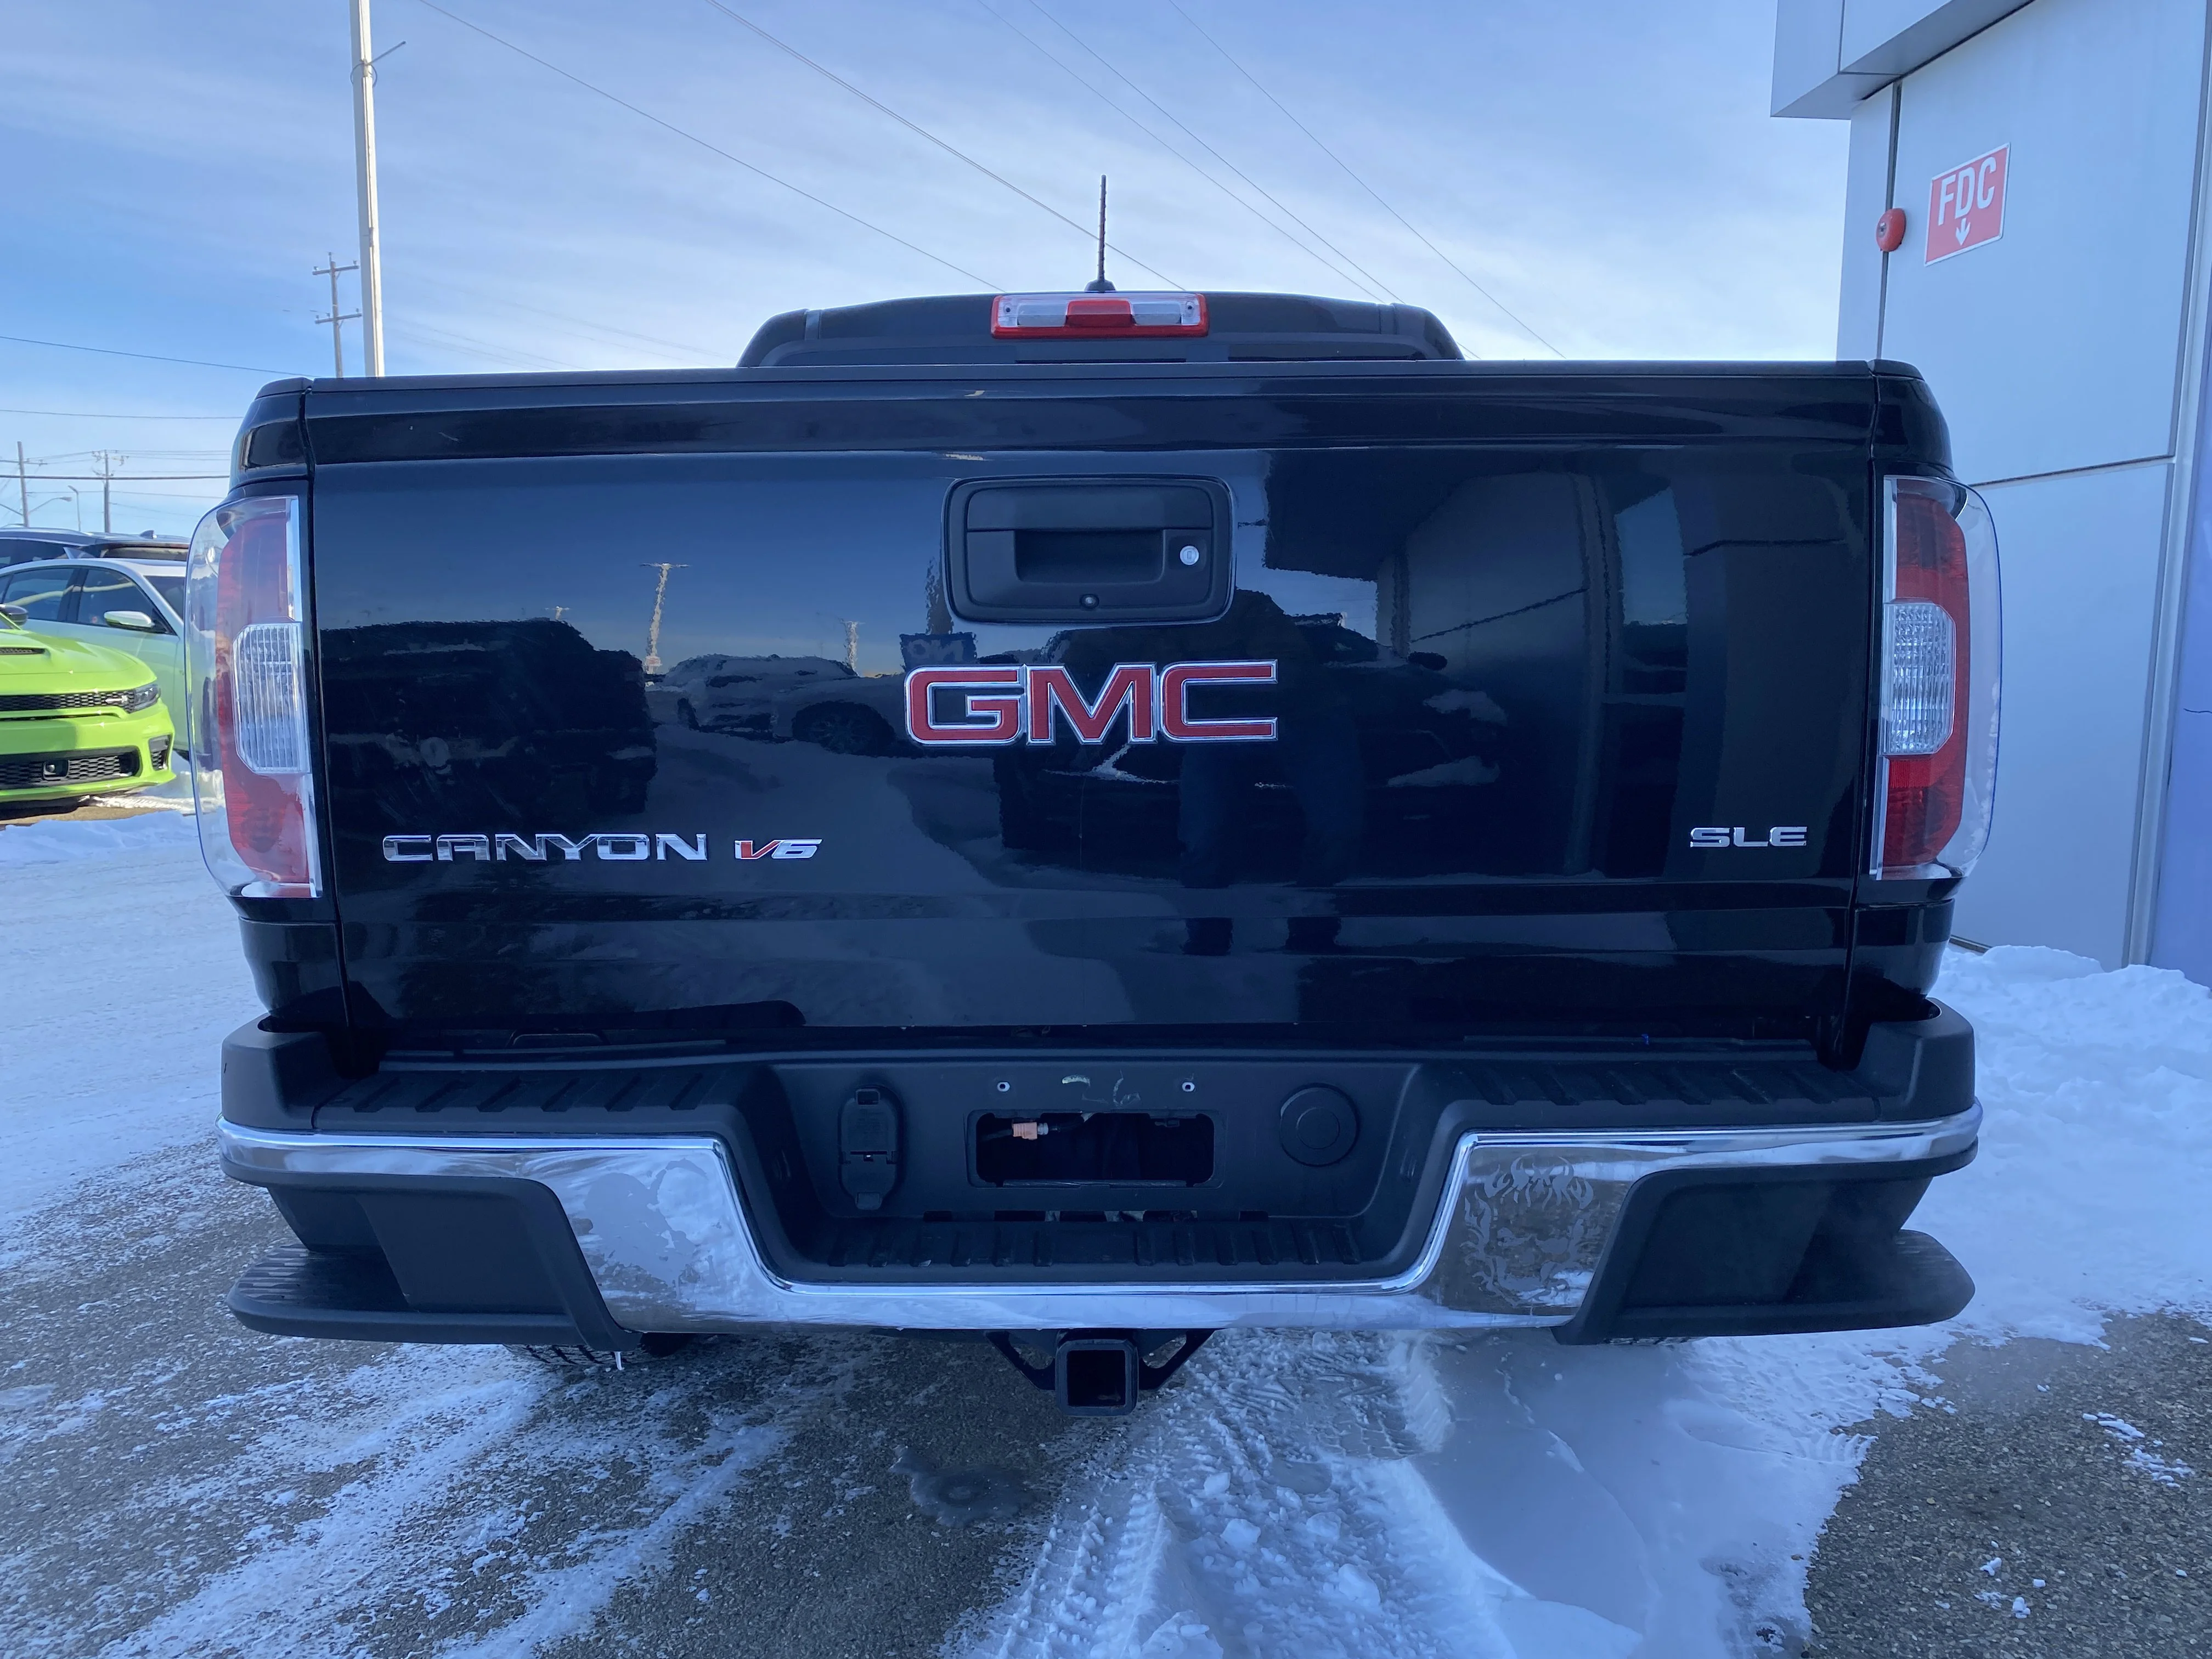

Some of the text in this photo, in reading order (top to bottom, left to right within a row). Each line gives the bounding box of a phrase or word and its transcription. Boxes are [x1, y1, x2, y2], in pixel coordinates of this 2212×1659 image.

[1938, 156, 1996, 225] FDC
[905, 659, 1278, 745] GMC
[382, 833, 823, 861] CANYON V6
[1690, 826, 1808, 848] SLE
